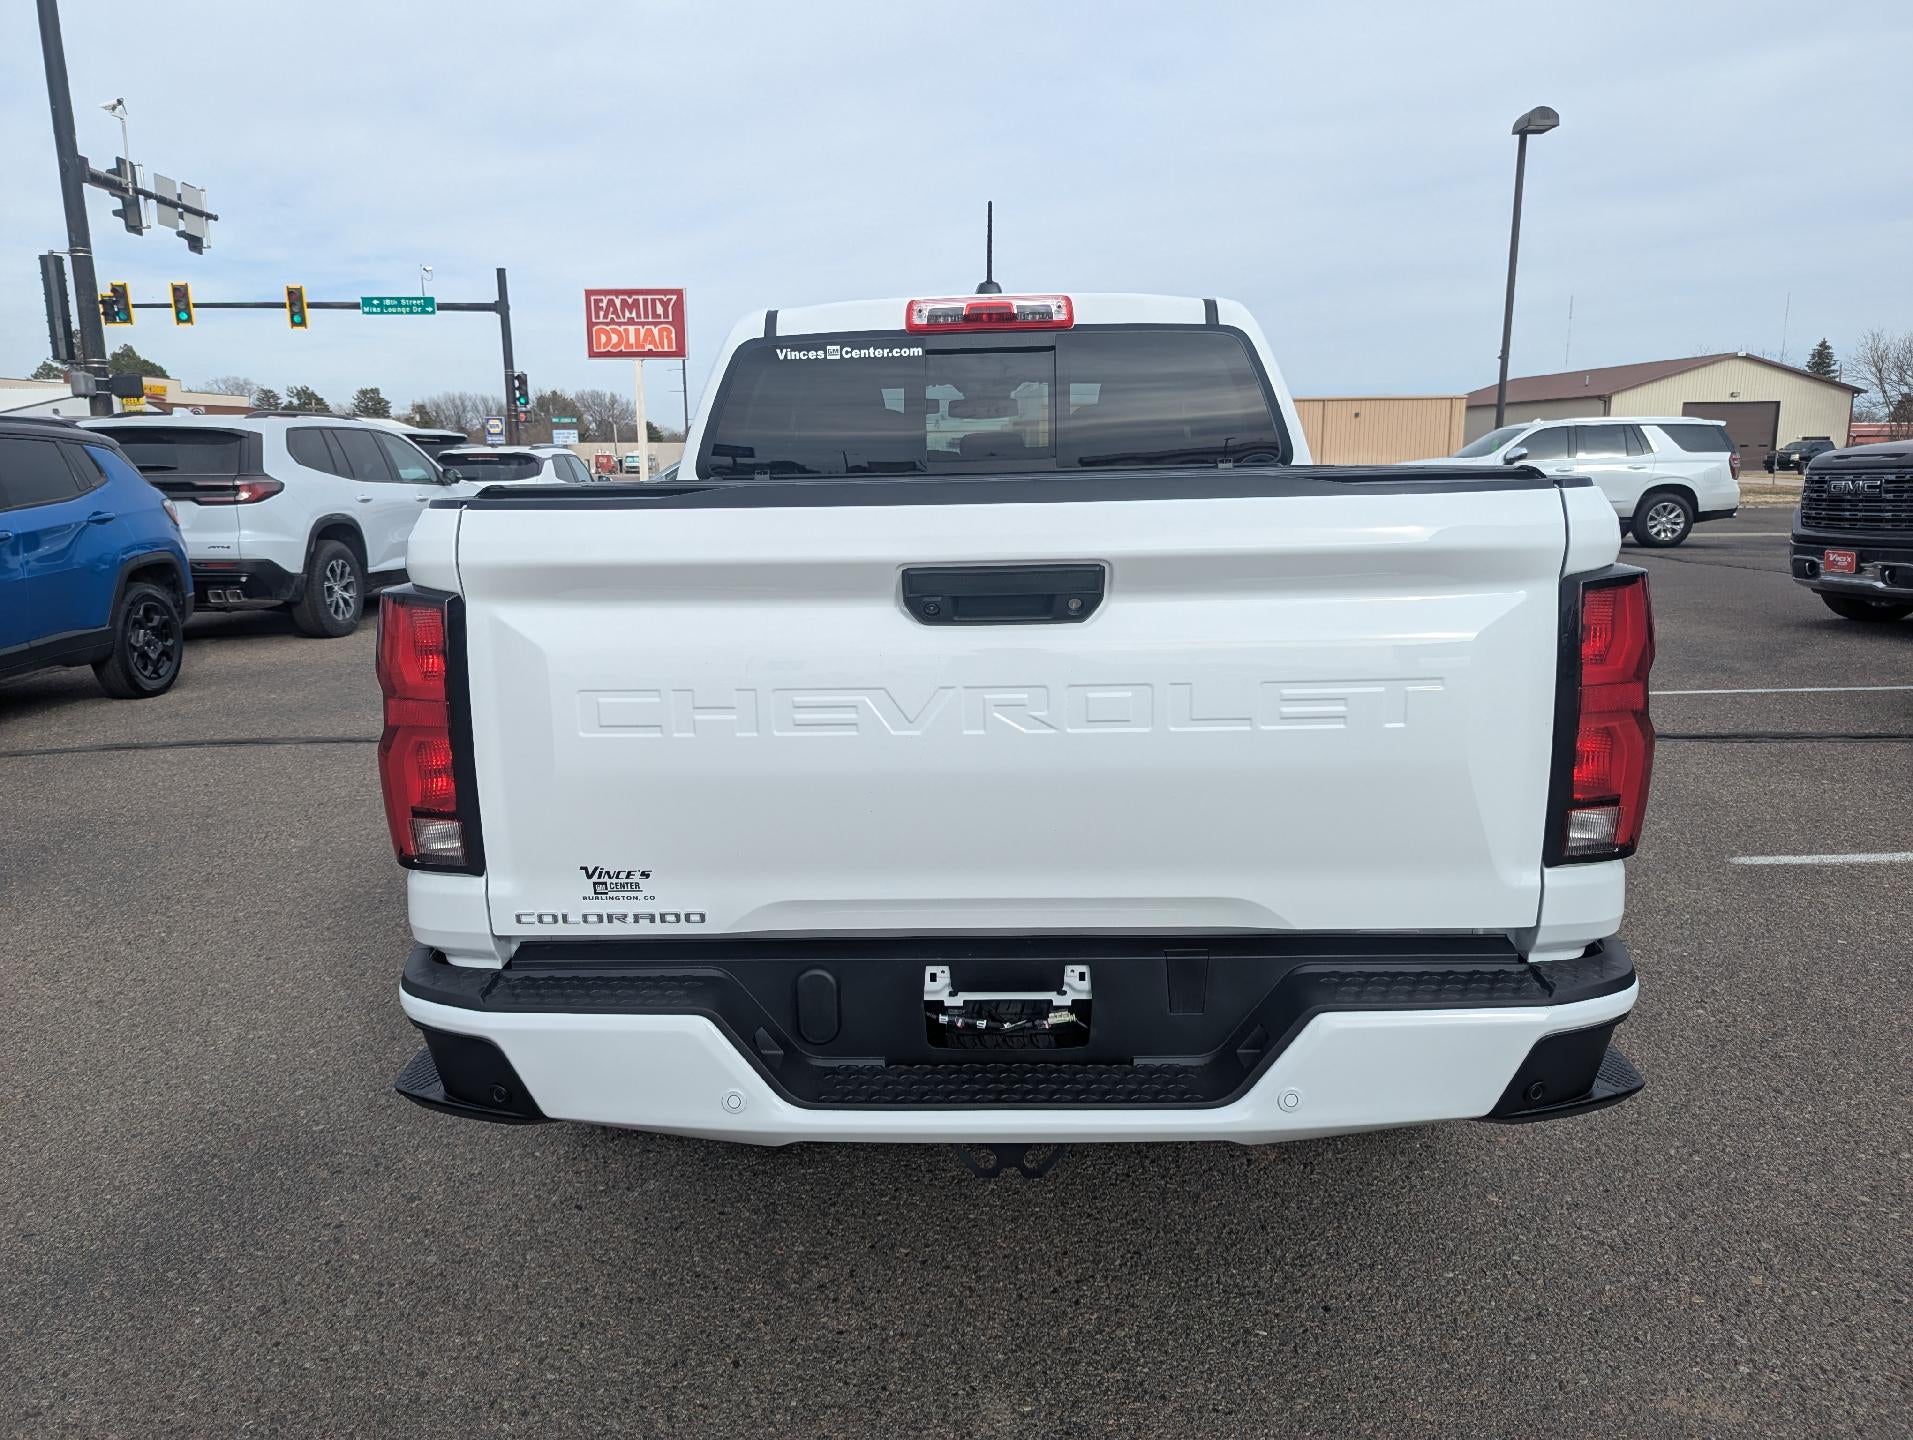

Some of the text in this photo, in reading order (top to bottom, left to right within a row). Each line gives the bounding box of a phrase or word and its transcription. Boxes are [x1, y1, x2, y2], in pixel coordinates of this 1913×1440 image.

[591, 295, 677, 322] FAMILY
[593, 325, 676, 352] DOLLAR
[776, 349, 825, 360] Vinces
[842, 347, 923, 359] Center.com
[1829, 480, 1881, 494] GMC
[577, 678, 1446, 738] CHEVROLET
[609, 881, 641, 890] CENTER
[514, 911, 707, 925] COLORADO
